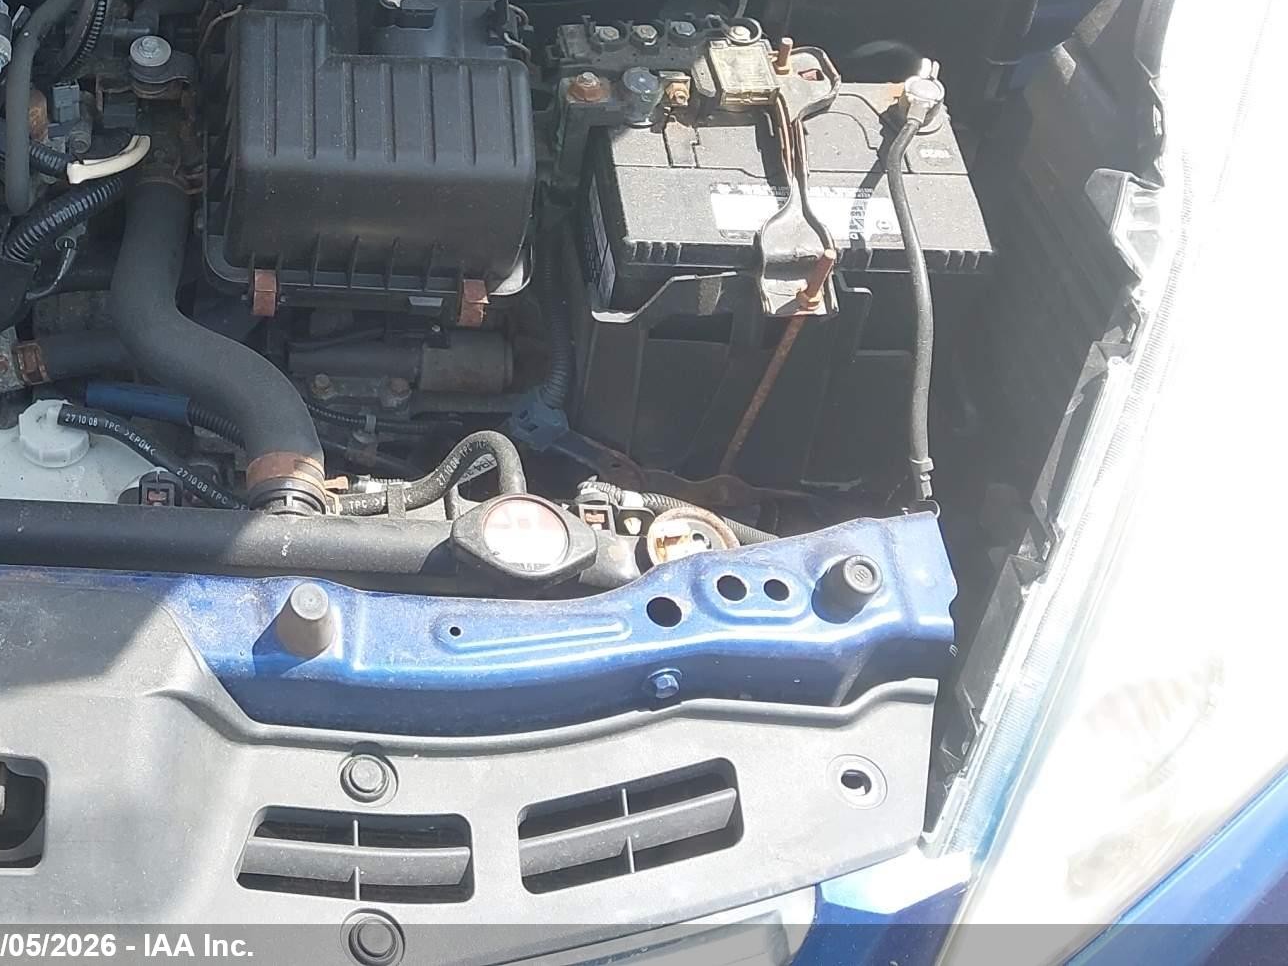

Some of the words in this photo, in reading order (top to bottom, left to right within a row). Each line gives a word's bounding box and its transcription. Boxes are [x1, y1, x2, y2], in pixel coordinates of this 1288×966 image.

[103, 417, 121, 432] TPC
[211, 490, 229, 505] TPC
[349, 499, 368, 511] TPC
